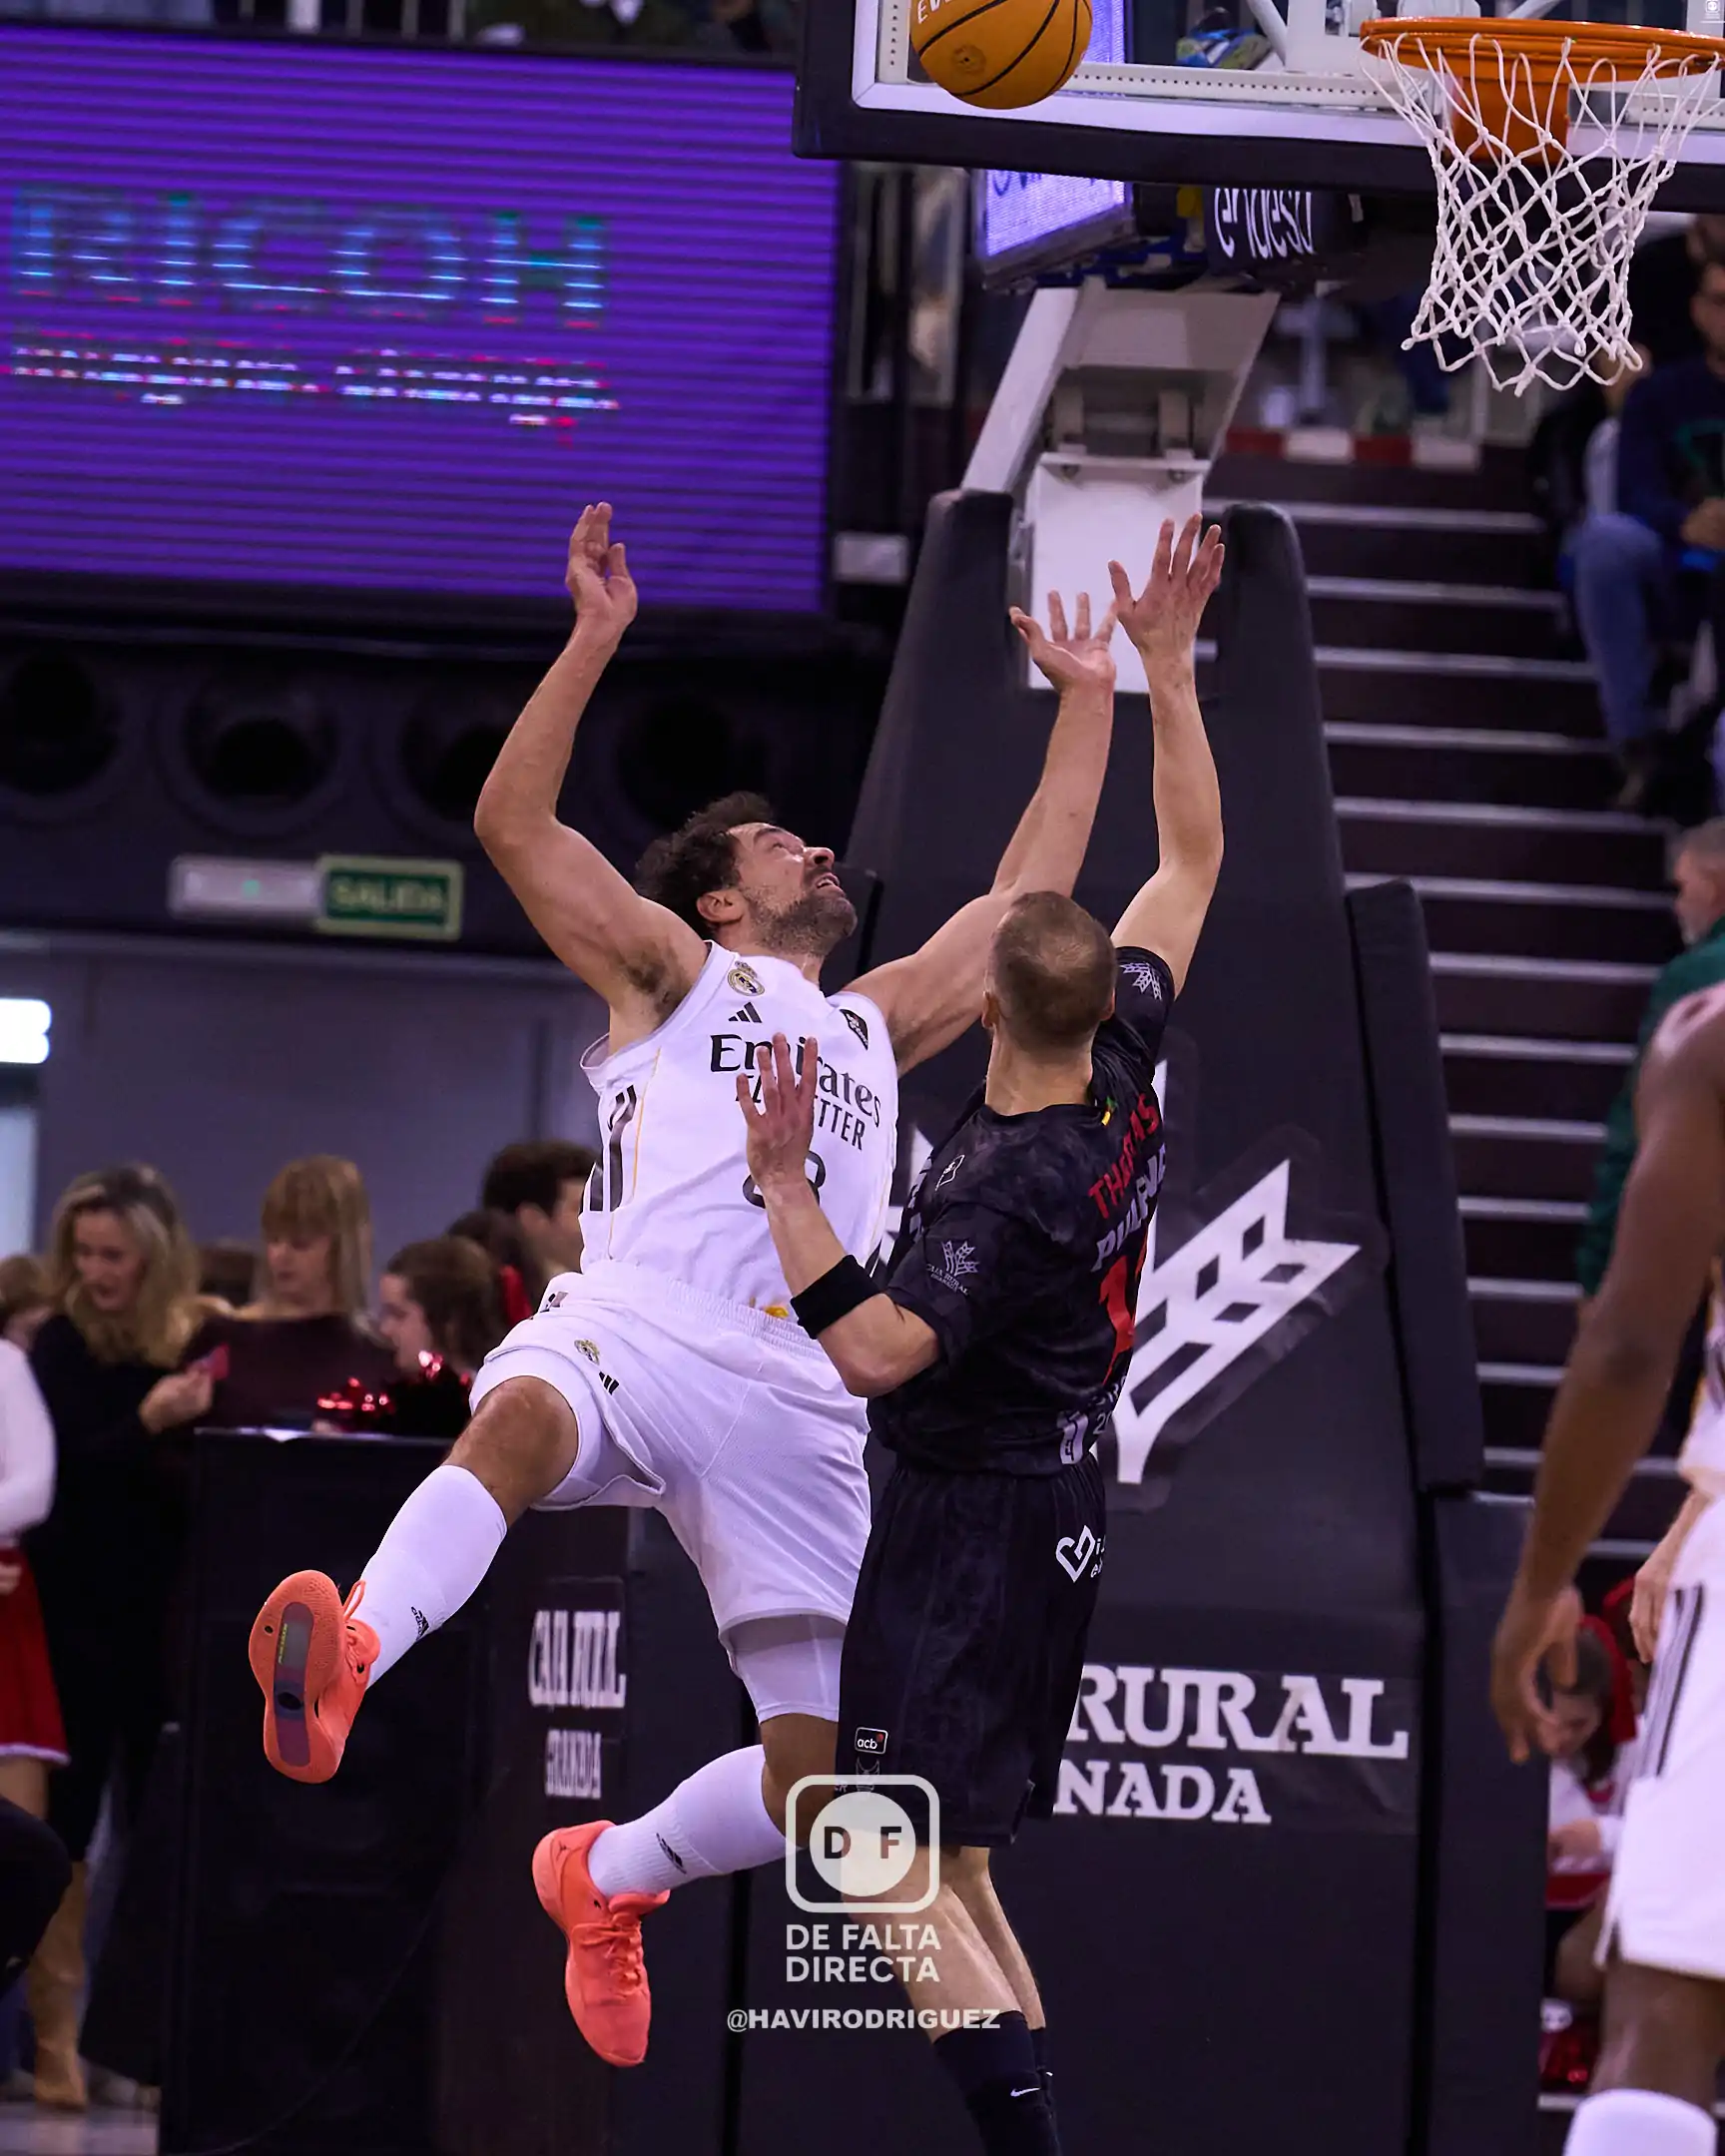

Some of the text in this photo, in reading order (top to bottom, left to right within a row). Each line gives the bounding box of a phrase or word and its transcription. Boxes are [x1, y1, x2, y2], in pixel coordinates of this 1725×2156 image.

[8, 187, 609, 330] RICOH
[710, 1033, 881, 1129] Emiates
[814, 1094, 866, 1151] TTER
[857, 1738, 878, 1750] acb
[1066, 1663, 1409, 1759] RURAL
